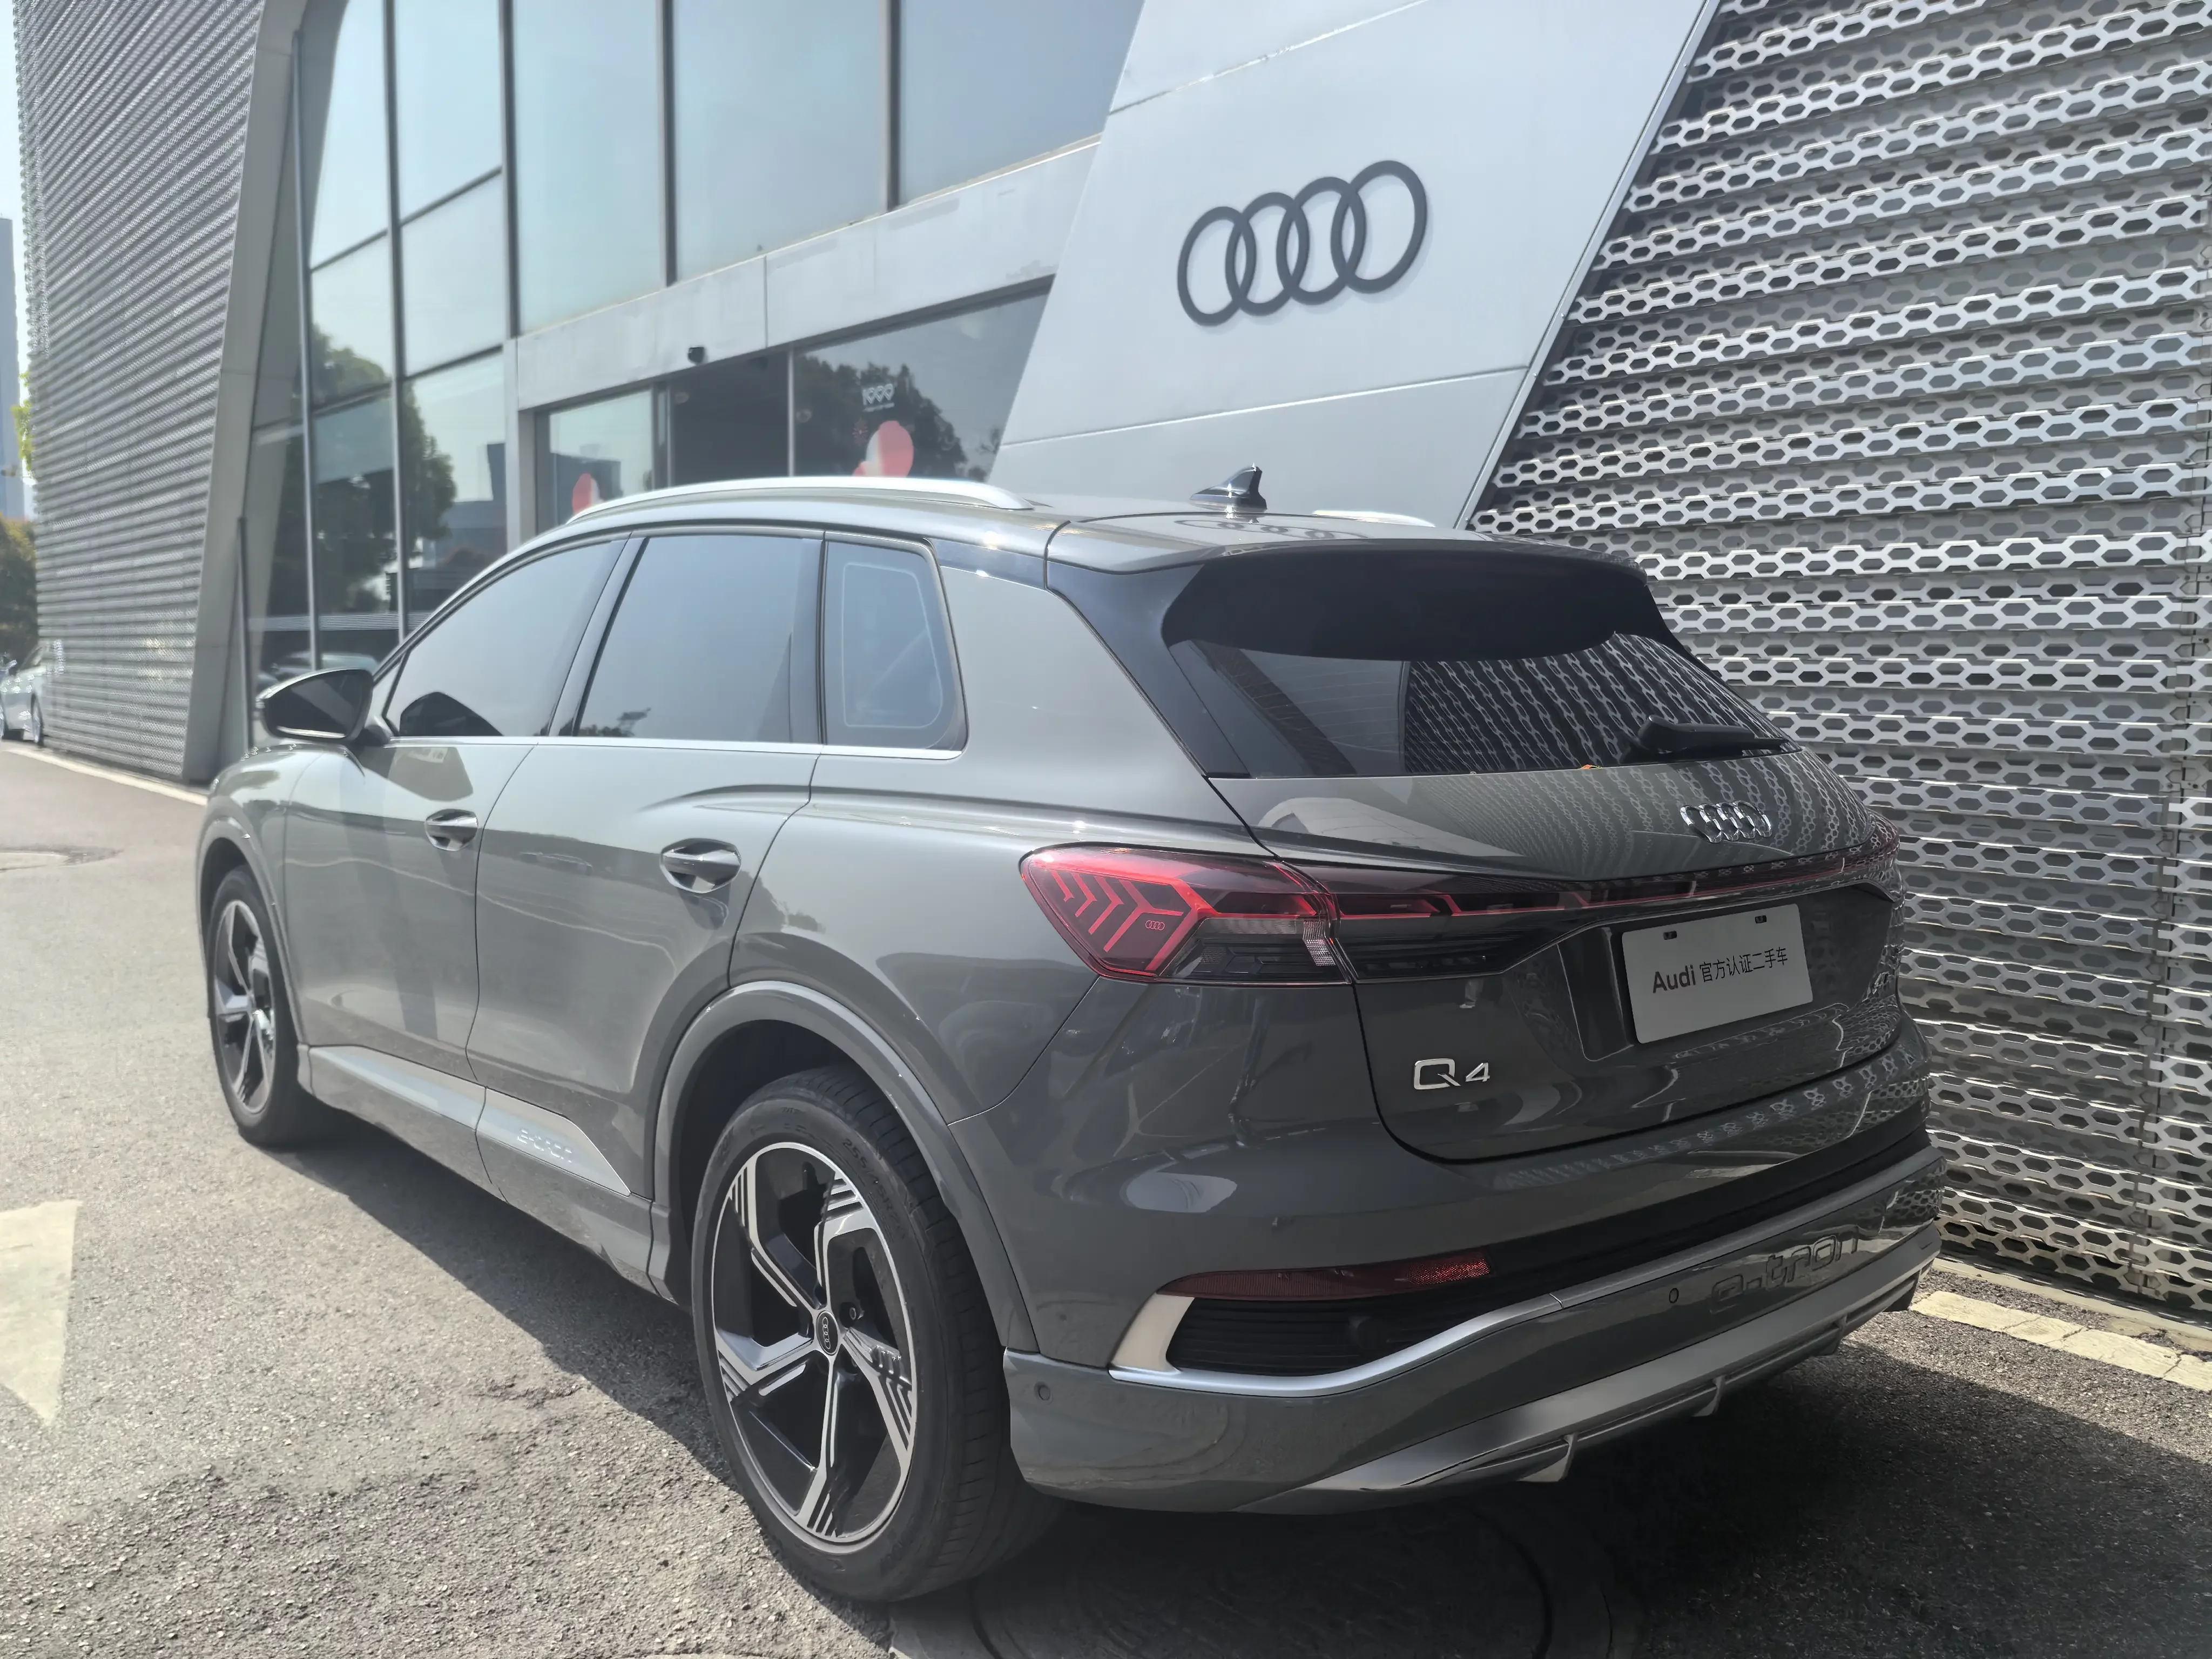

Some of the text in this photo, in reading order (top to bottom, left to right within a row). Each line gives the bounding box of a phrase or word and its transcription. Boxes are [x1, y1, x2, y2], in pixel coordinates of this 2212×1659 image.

[1653, 947, 1788, 994] Audi 官方认证二手车
[1710, 1225, 1859, 1314] e-tron
